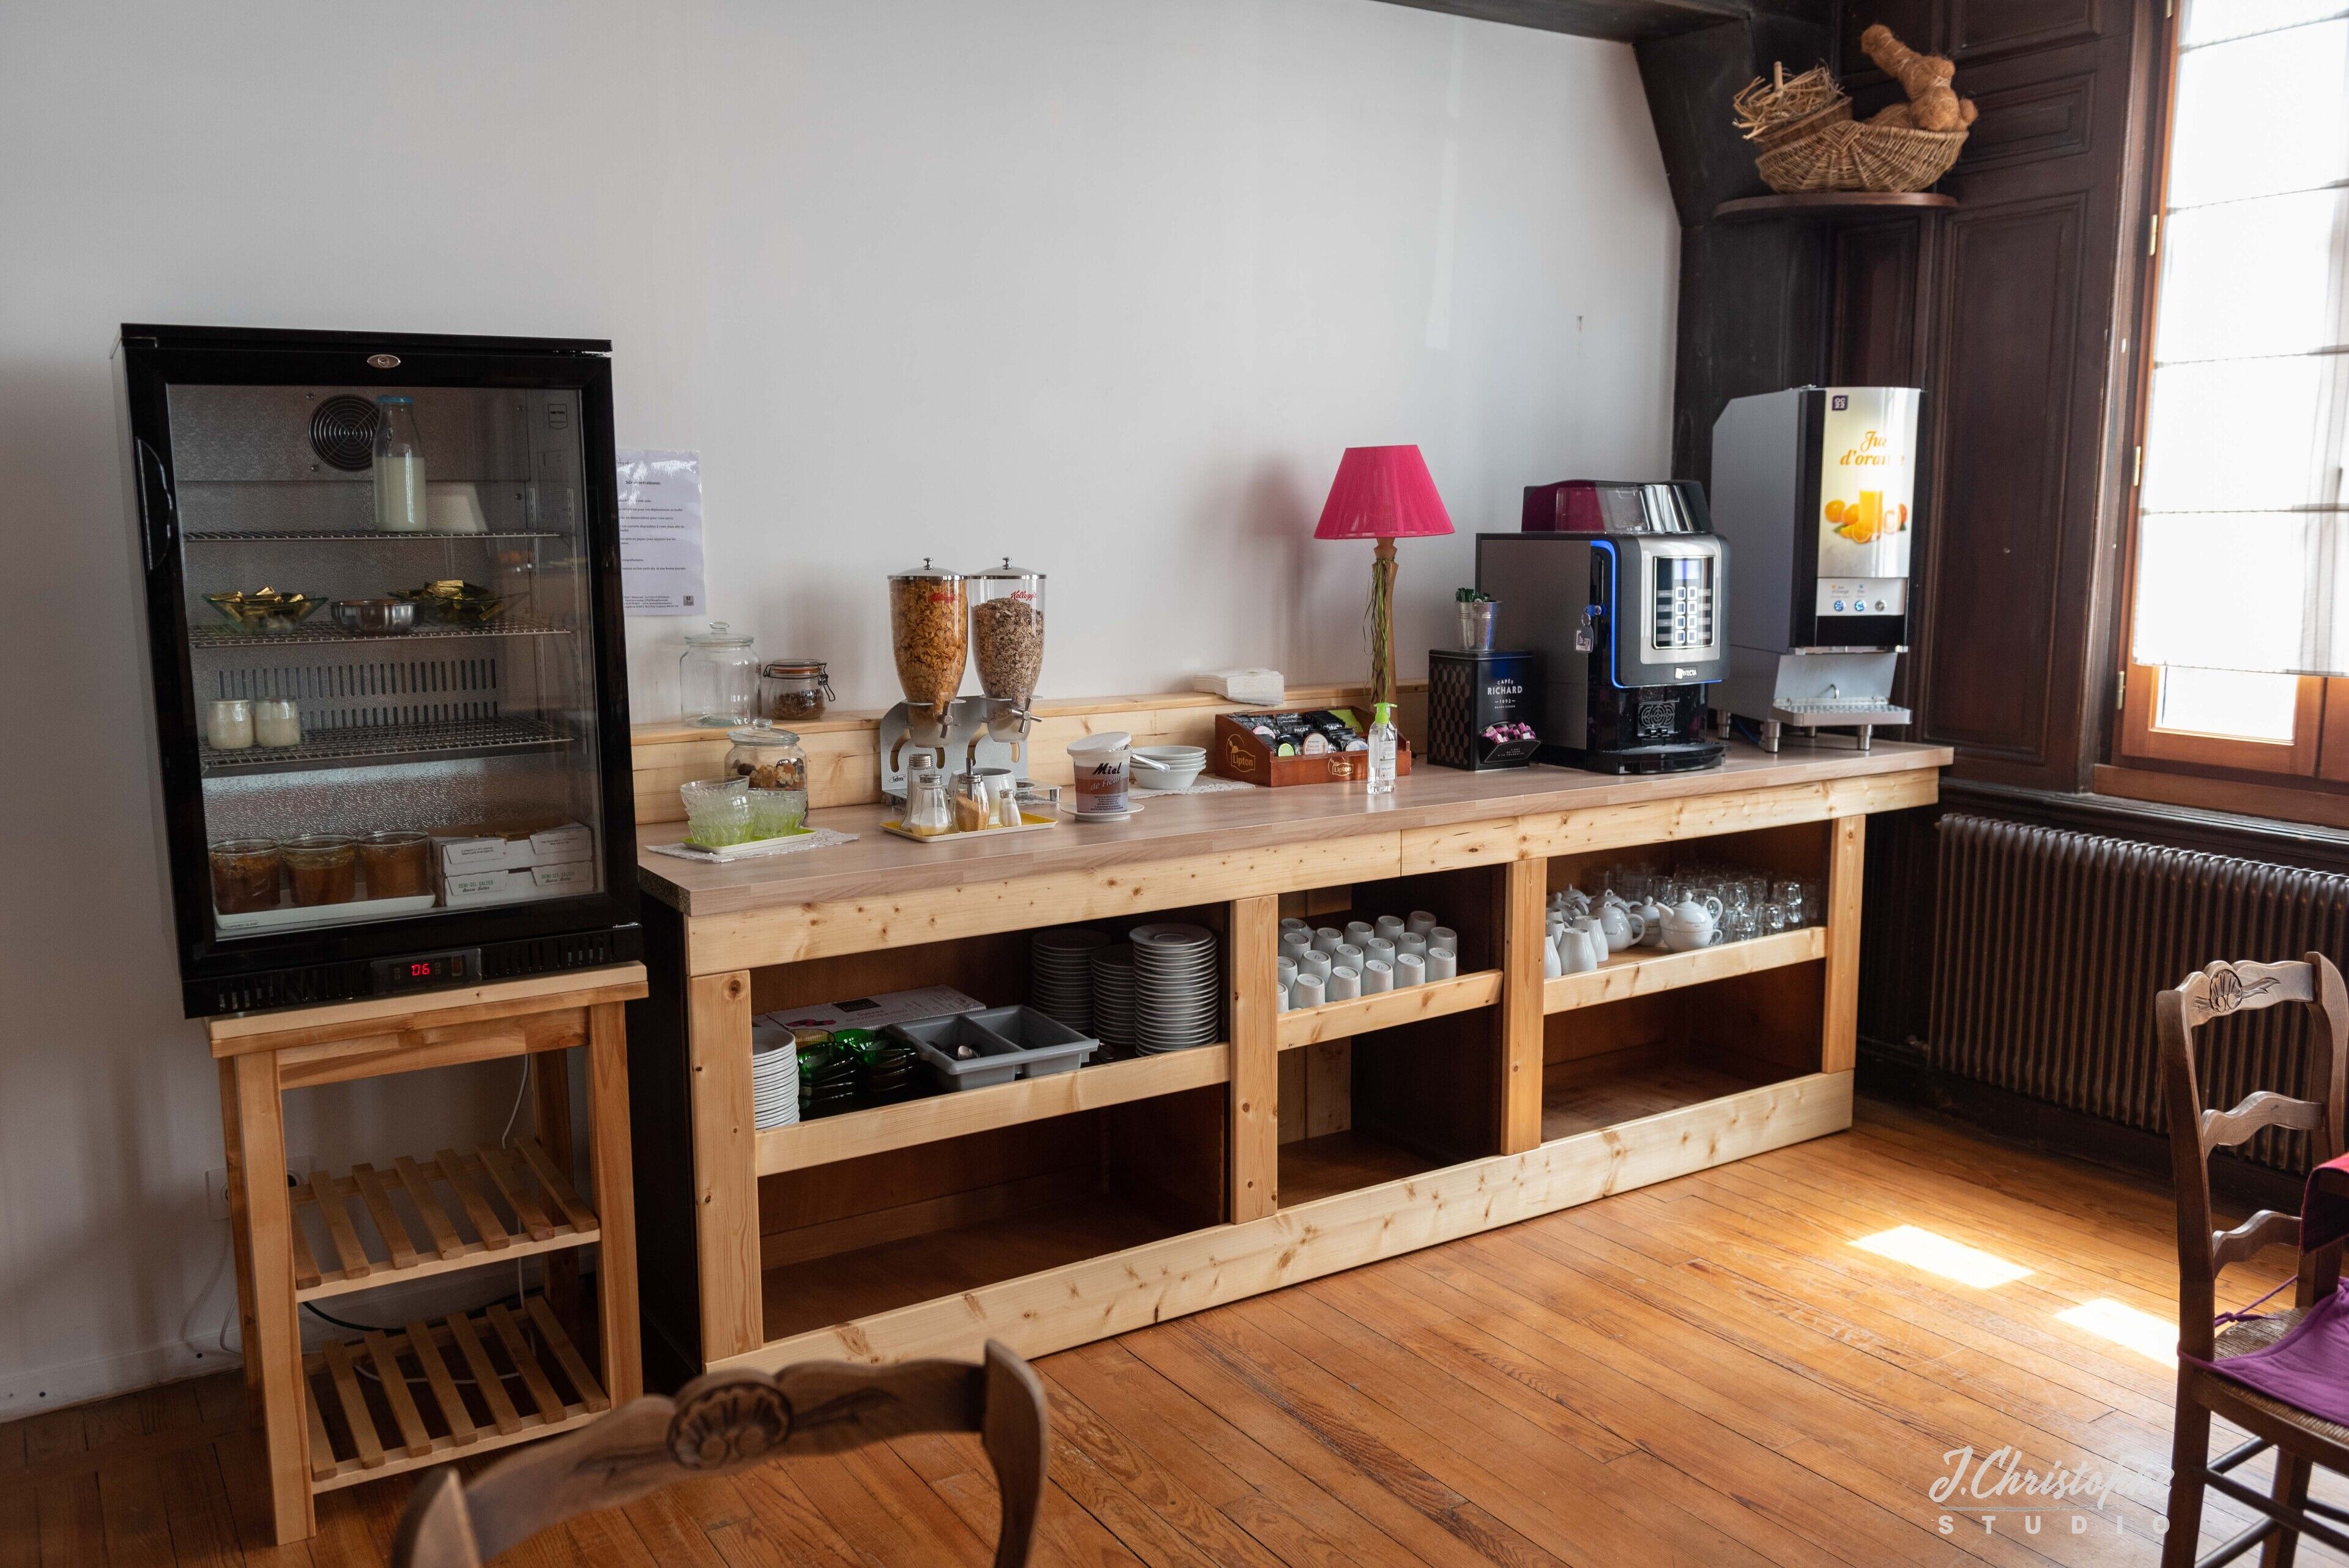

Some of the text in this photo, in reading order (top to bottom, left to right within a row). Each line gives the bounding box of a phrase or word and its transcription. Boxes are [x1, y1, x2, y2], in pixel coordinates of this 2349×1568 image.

[1487, 686, 1523, 695] RICHARD
[1233, 754, 1253, 767] Lipton
[1093, 762, 1122, 775] Miel
[1102, 775, 1125, 787] Fleurs
[411, 963, 430, 976] 06
